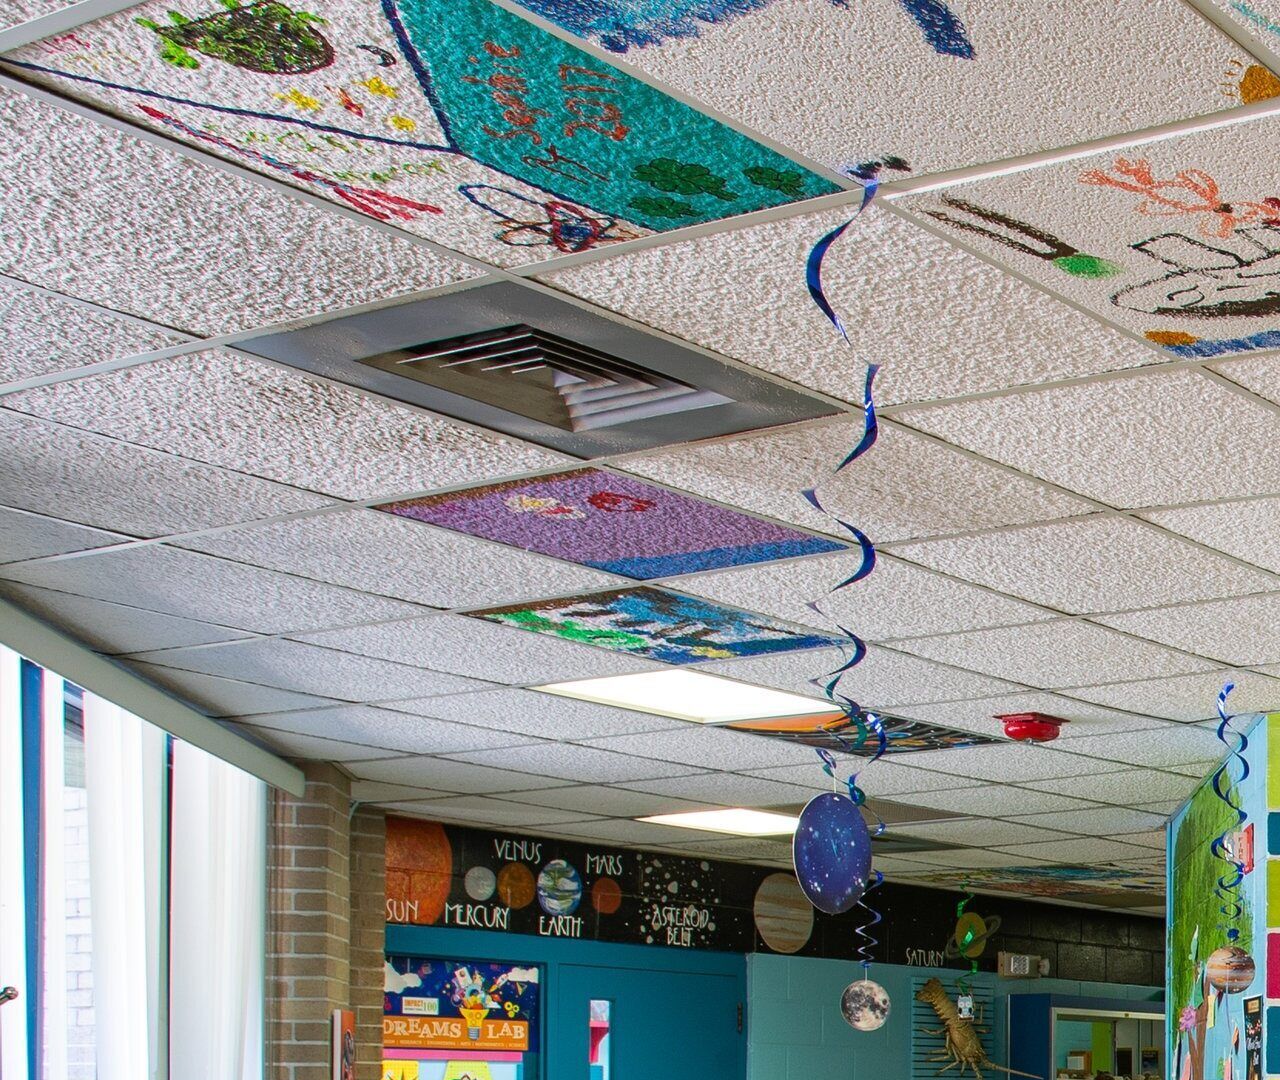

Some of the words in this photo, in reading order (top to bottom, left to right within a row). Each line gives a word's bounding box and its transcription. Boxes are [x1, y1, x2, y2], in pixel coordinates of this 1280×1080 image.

[494, 838, 543, 864] VENUS
[586, 853, 623, 876] MARS
[385, 899, 418, 922] SUN
[445, 903, 510, 930] MERCURY
[652, 904, 709, 929] ASTEROID
[539, 916, 582, 938] EARTH
[666, 926, 694, 947] BELT
[905, 947, 945, 968] SATURN
[487, 1022, 526, 1040] LAB
